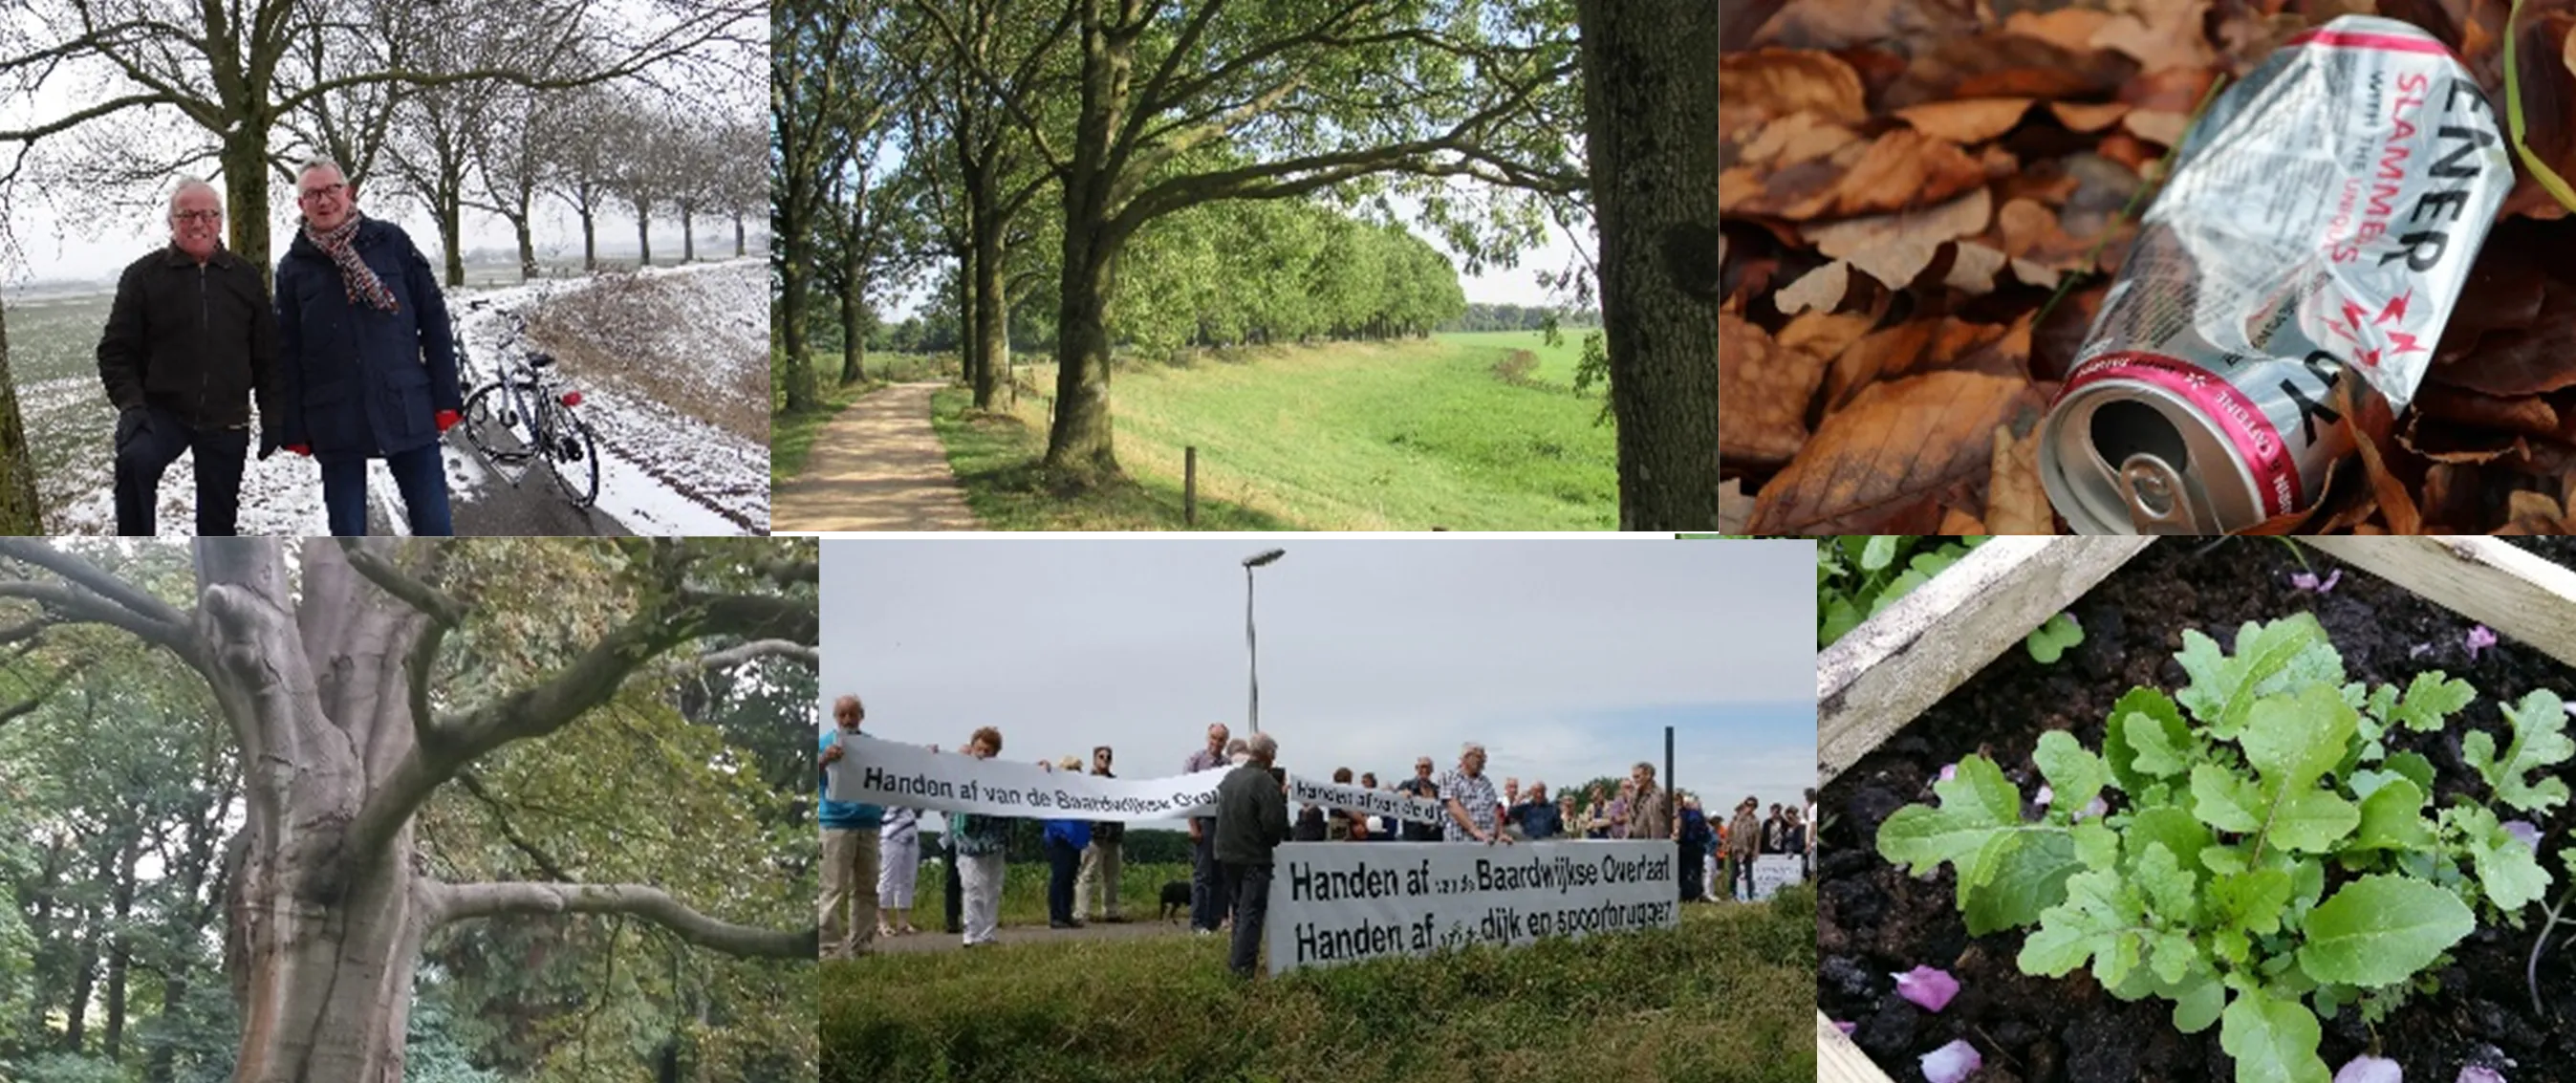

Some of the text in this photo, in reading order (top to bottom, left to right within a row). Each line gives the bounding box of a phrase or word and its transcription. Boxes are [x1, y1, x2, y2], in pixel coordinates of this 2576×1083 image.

[2365, 70, 2385, 127] WITH
[2349, 134, 2375, 171] THE
[863, 767, 954, 798] Handen
[960, 780, 978, 801] af
[983, 786, 1021, 805] van
[1027, 788, 1051, 808] de
[1290, 861, 1399, 901] Handen
[1407, 858, 1430, 896] af
[1476, 856, 1597, 895] Baardwijkse
[1602, 854, 1671, 883] Overlaat
[1295, 918, 1404, 962] Handen
[1412, 911, 1434, 950] af
[1482, 907, 1523, 946] dijk
[1526, 910, 1552, 938] en
